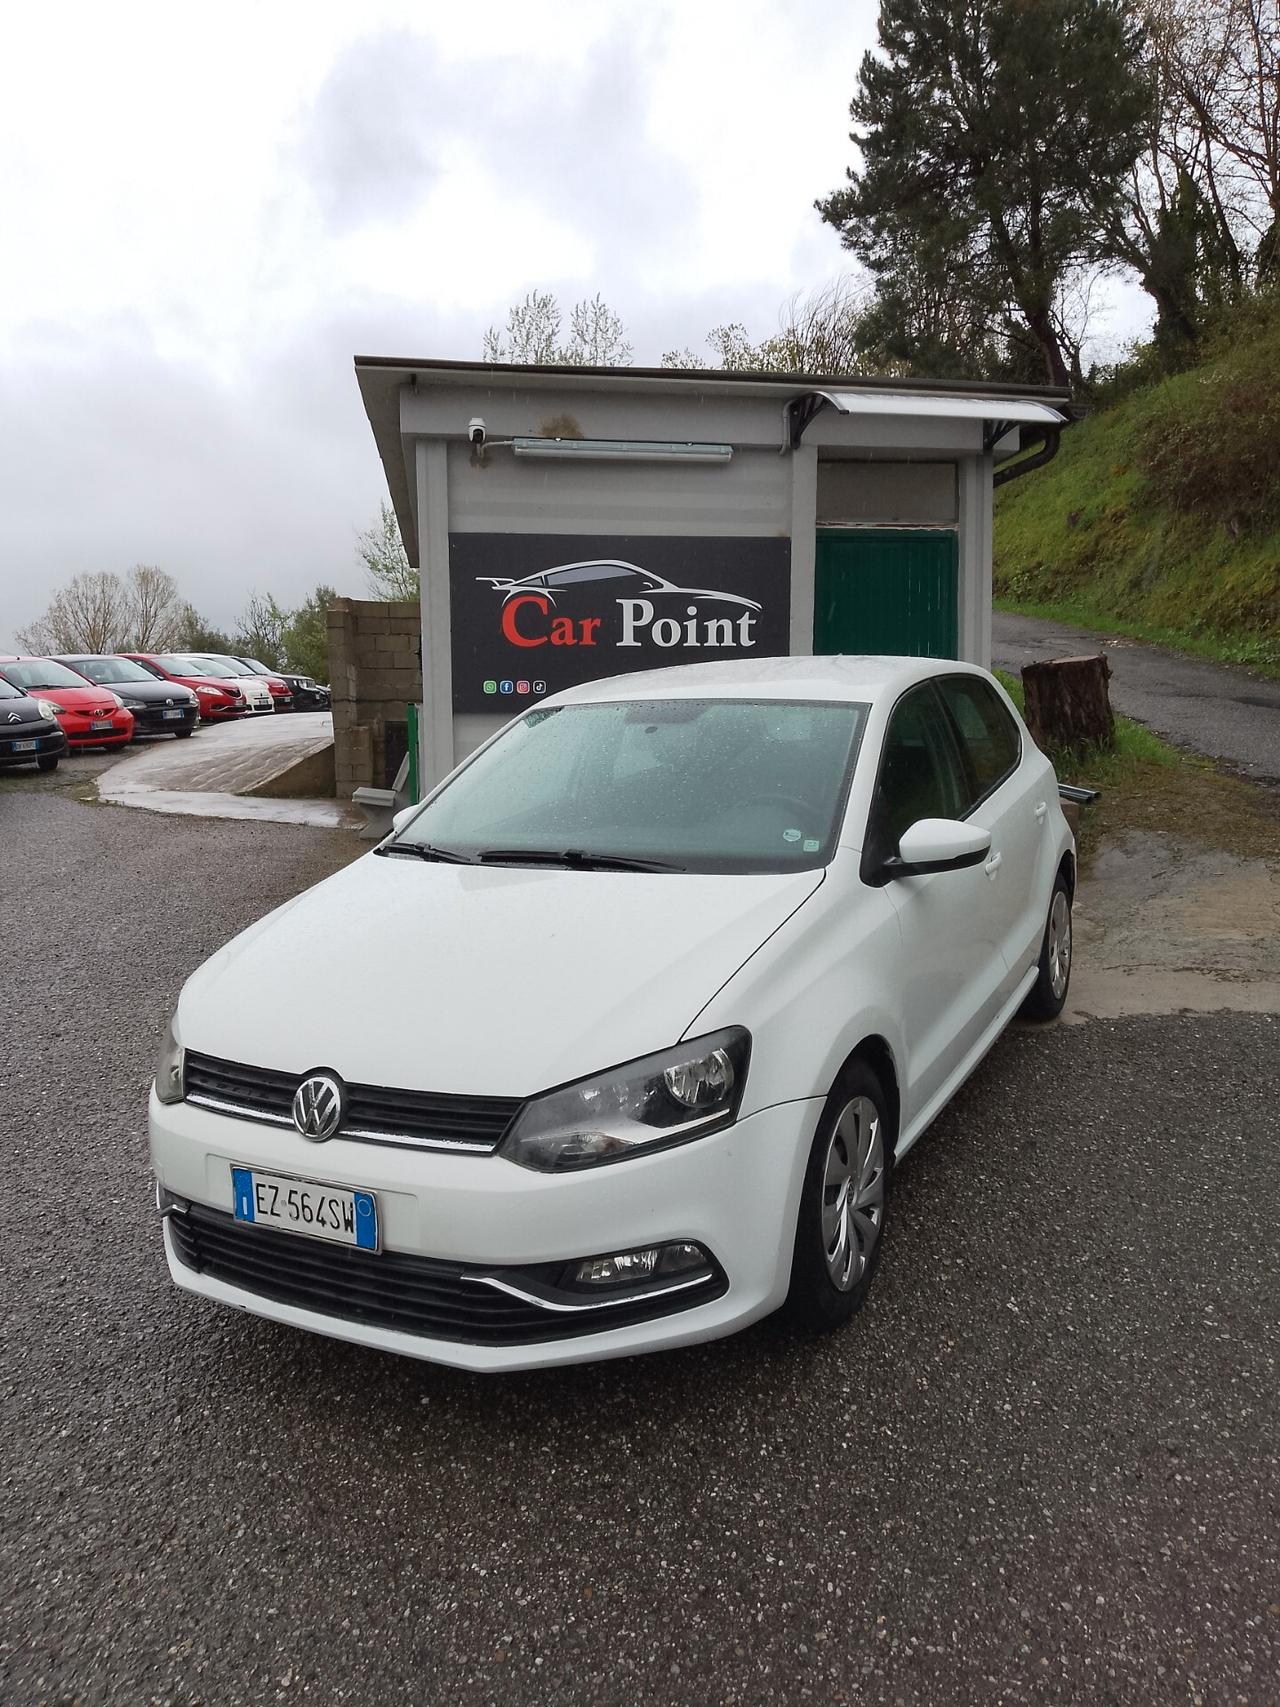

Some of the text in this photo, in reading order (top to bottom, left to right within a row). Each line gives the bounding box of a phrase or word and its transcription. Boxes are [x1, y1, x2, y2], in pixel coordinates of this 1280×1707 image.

[502, 595, 757, 647] Car Point
[255, 1182, 354, 1234] EZ 564SW
